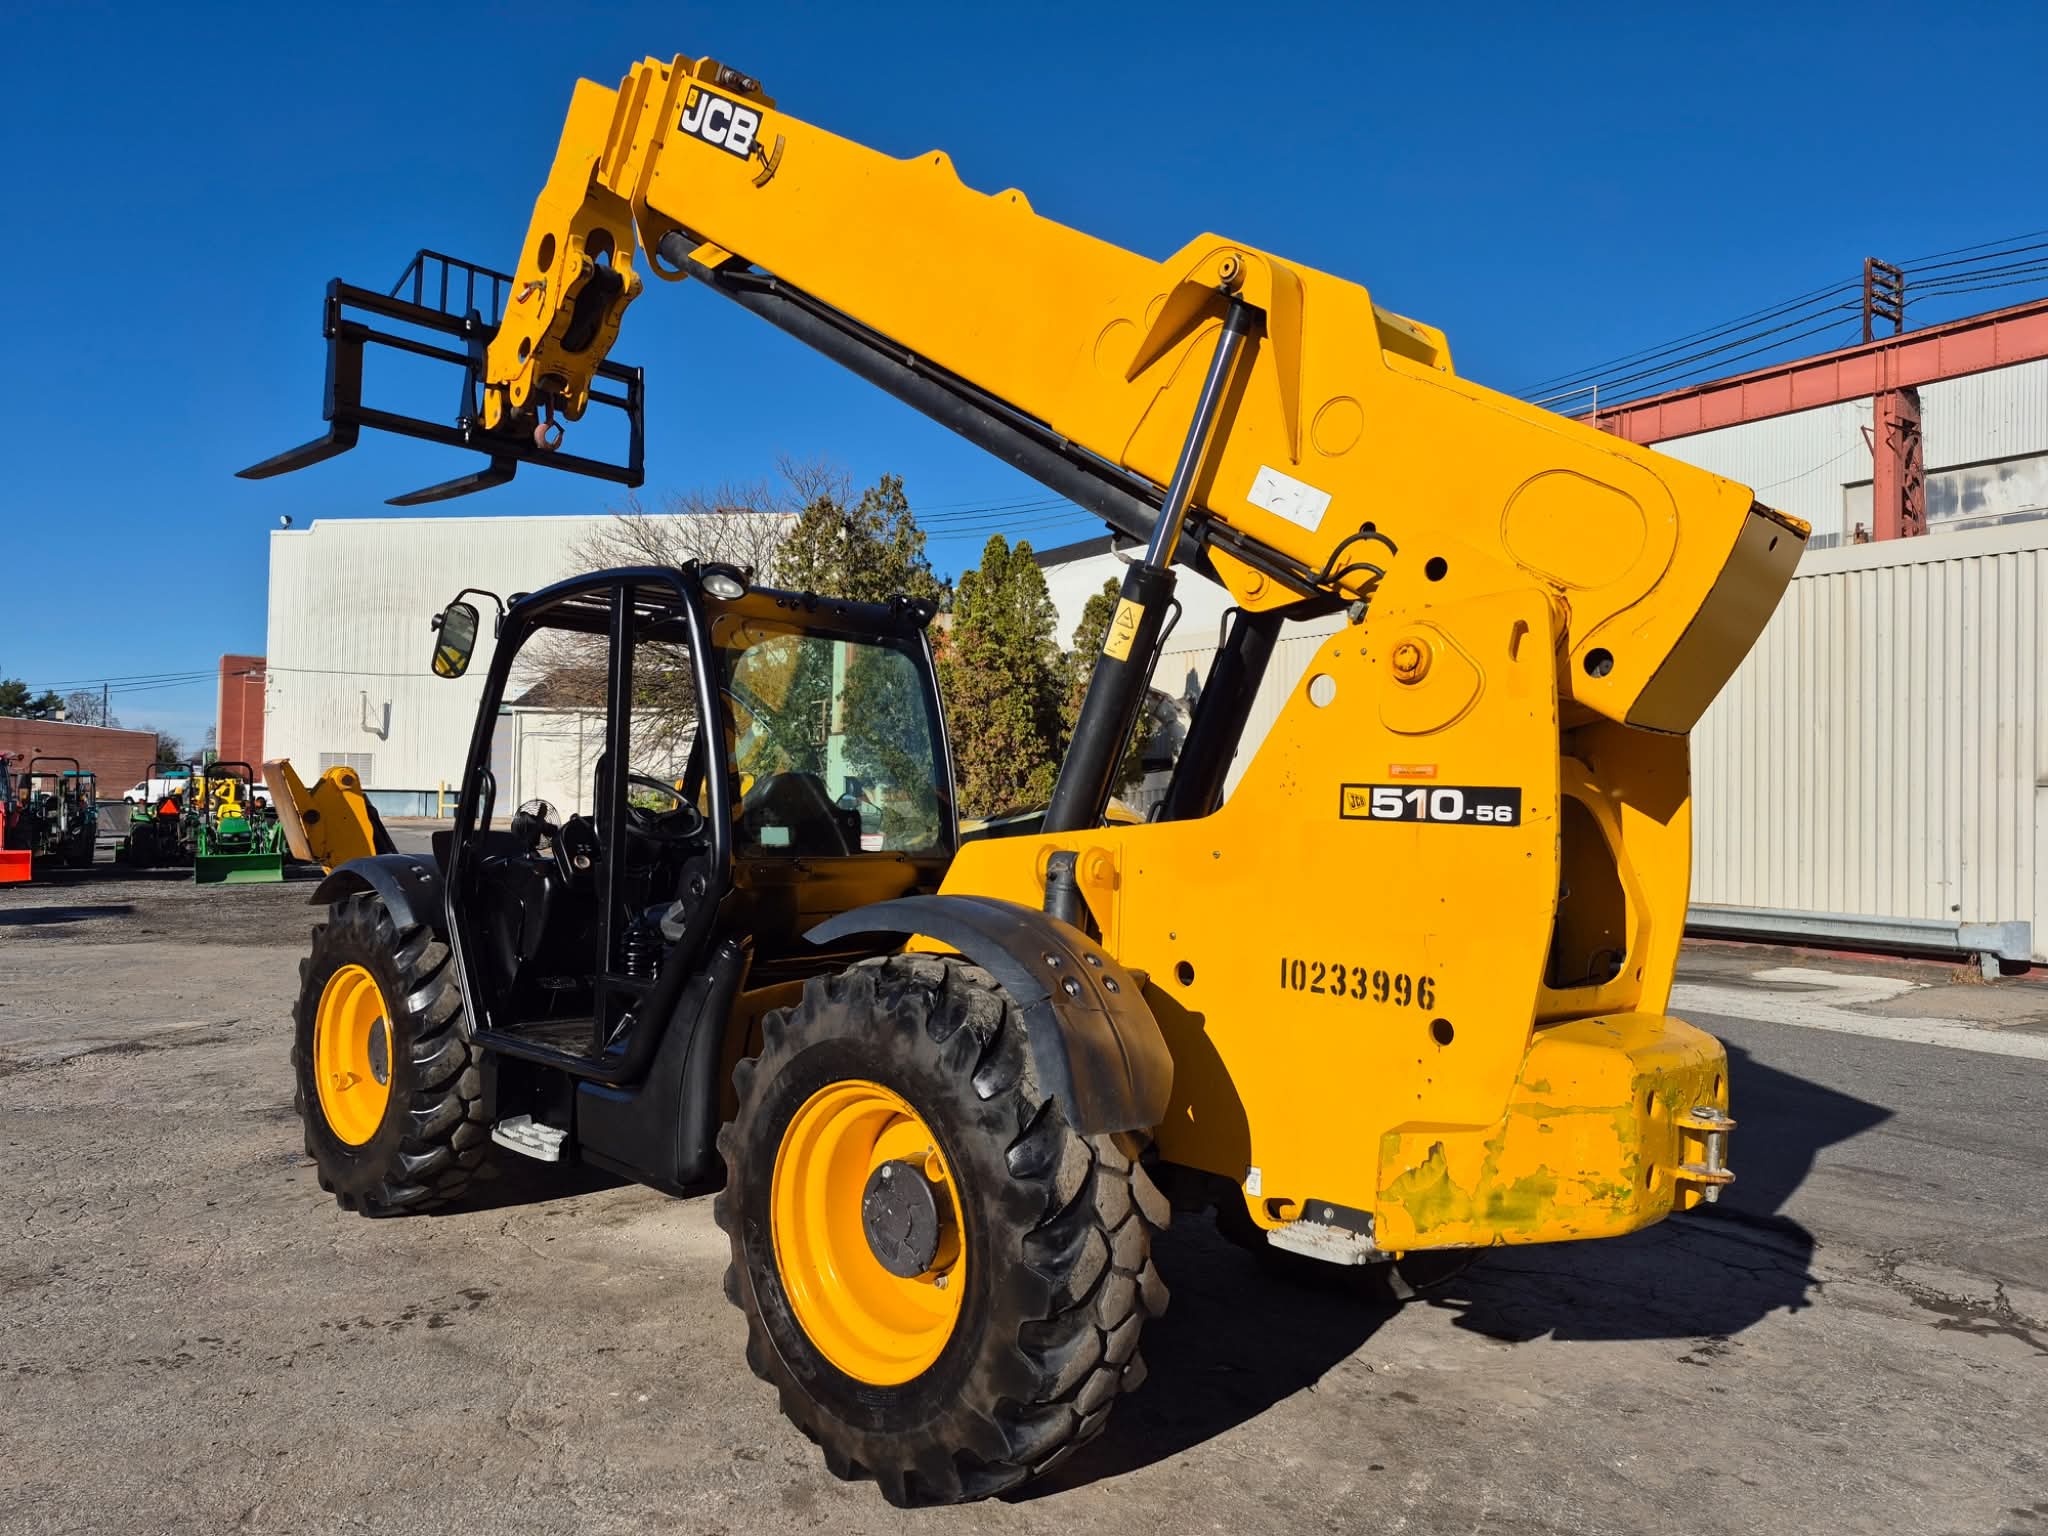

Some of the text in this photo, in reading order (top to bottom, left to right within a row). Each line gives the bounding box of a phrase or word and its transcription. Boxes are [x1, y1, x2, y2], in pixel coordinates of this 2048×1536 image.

[681, 93, 758, 155] JCB
[1371, 788, 1513, 822] 510-56
[1281, 957, 1436, 1011] 10233996
